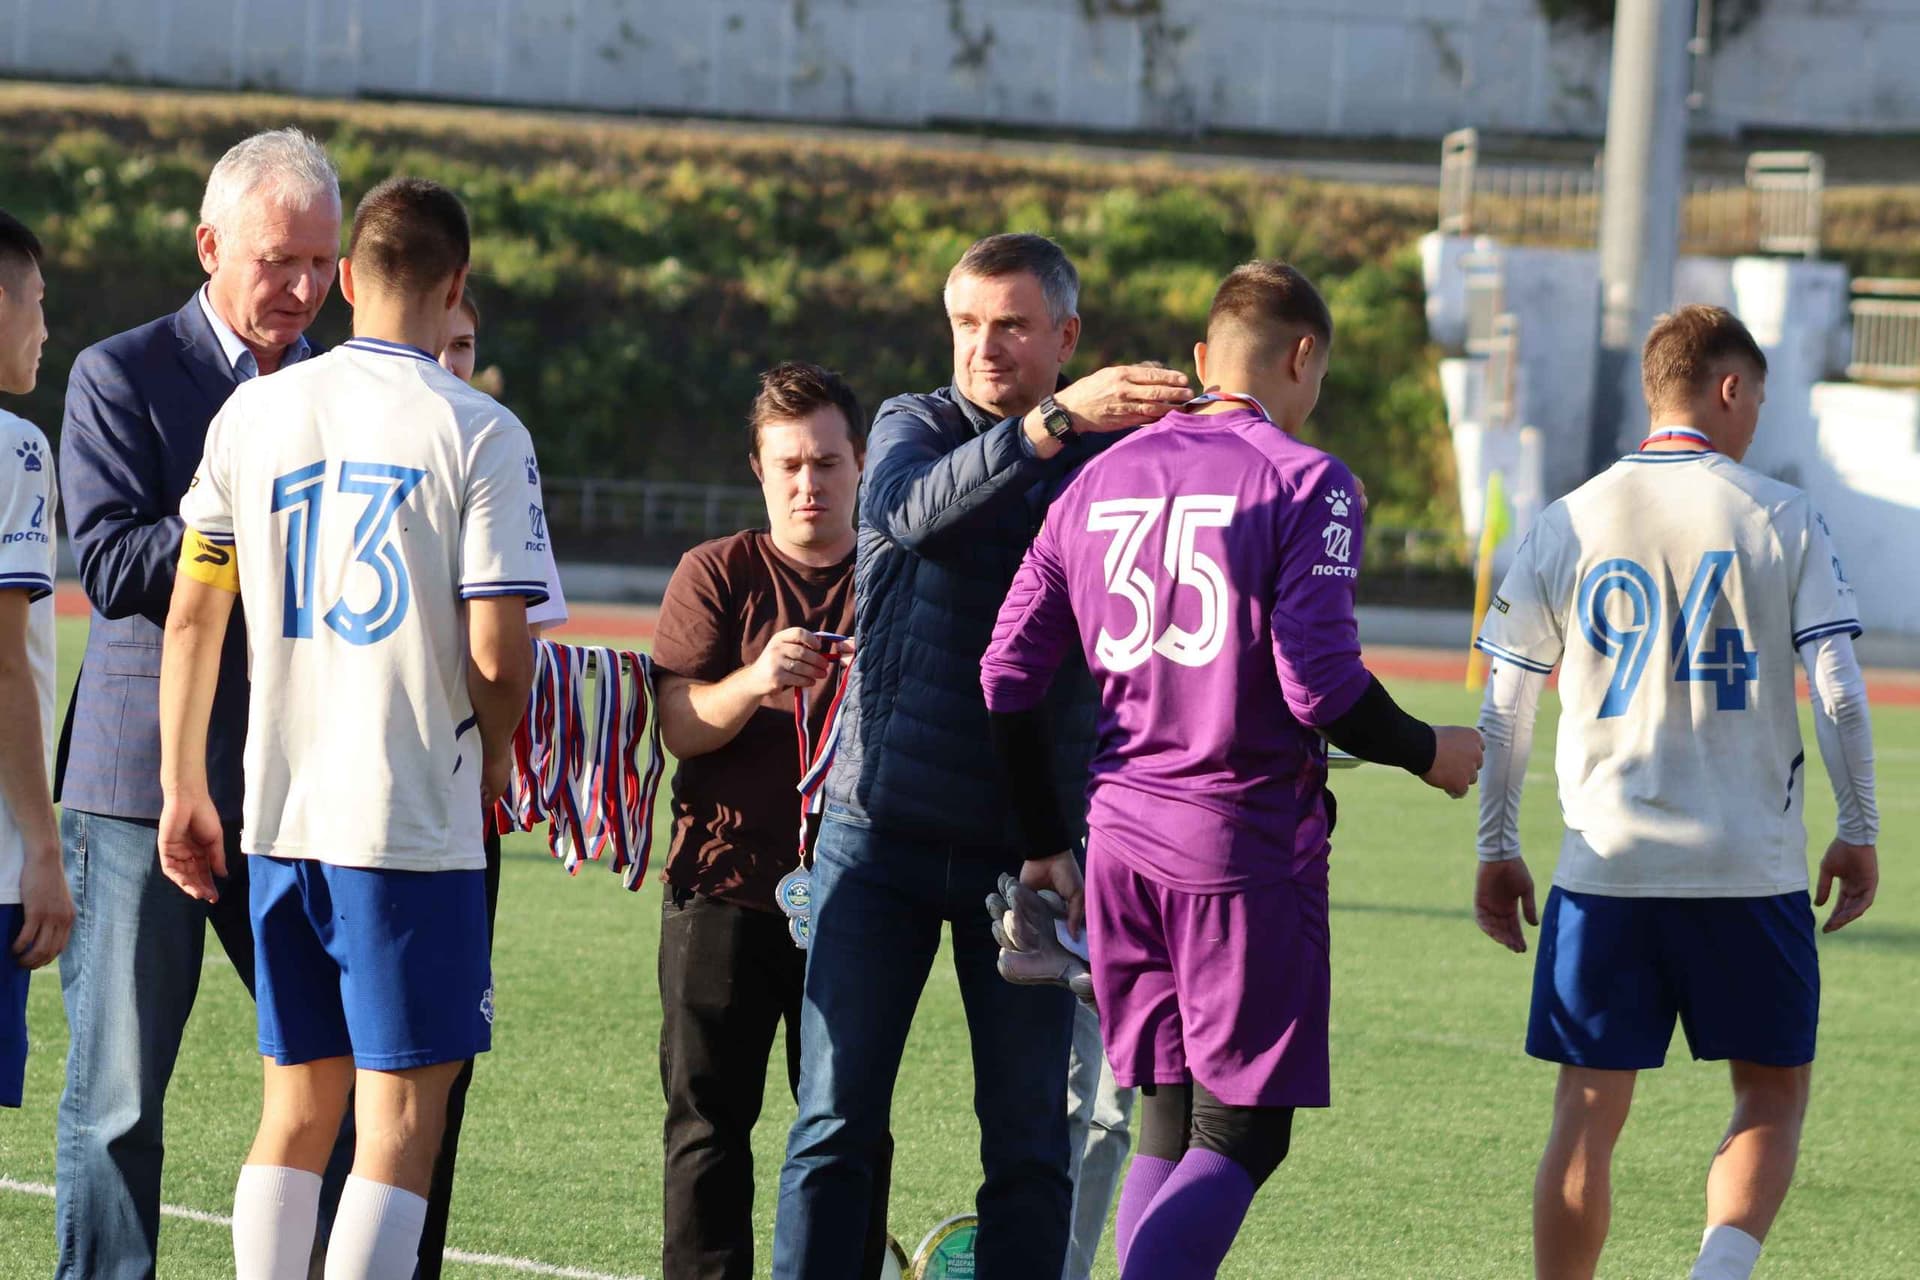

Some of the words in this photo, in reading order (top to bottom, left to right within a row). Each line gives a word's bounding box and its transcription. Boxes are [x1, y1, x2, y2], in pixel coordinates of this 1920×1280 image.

[272, 459, 428, 646] 13
[1086, 495, 1238, 673] 35
[1577, 550, 1759, 720] 94
